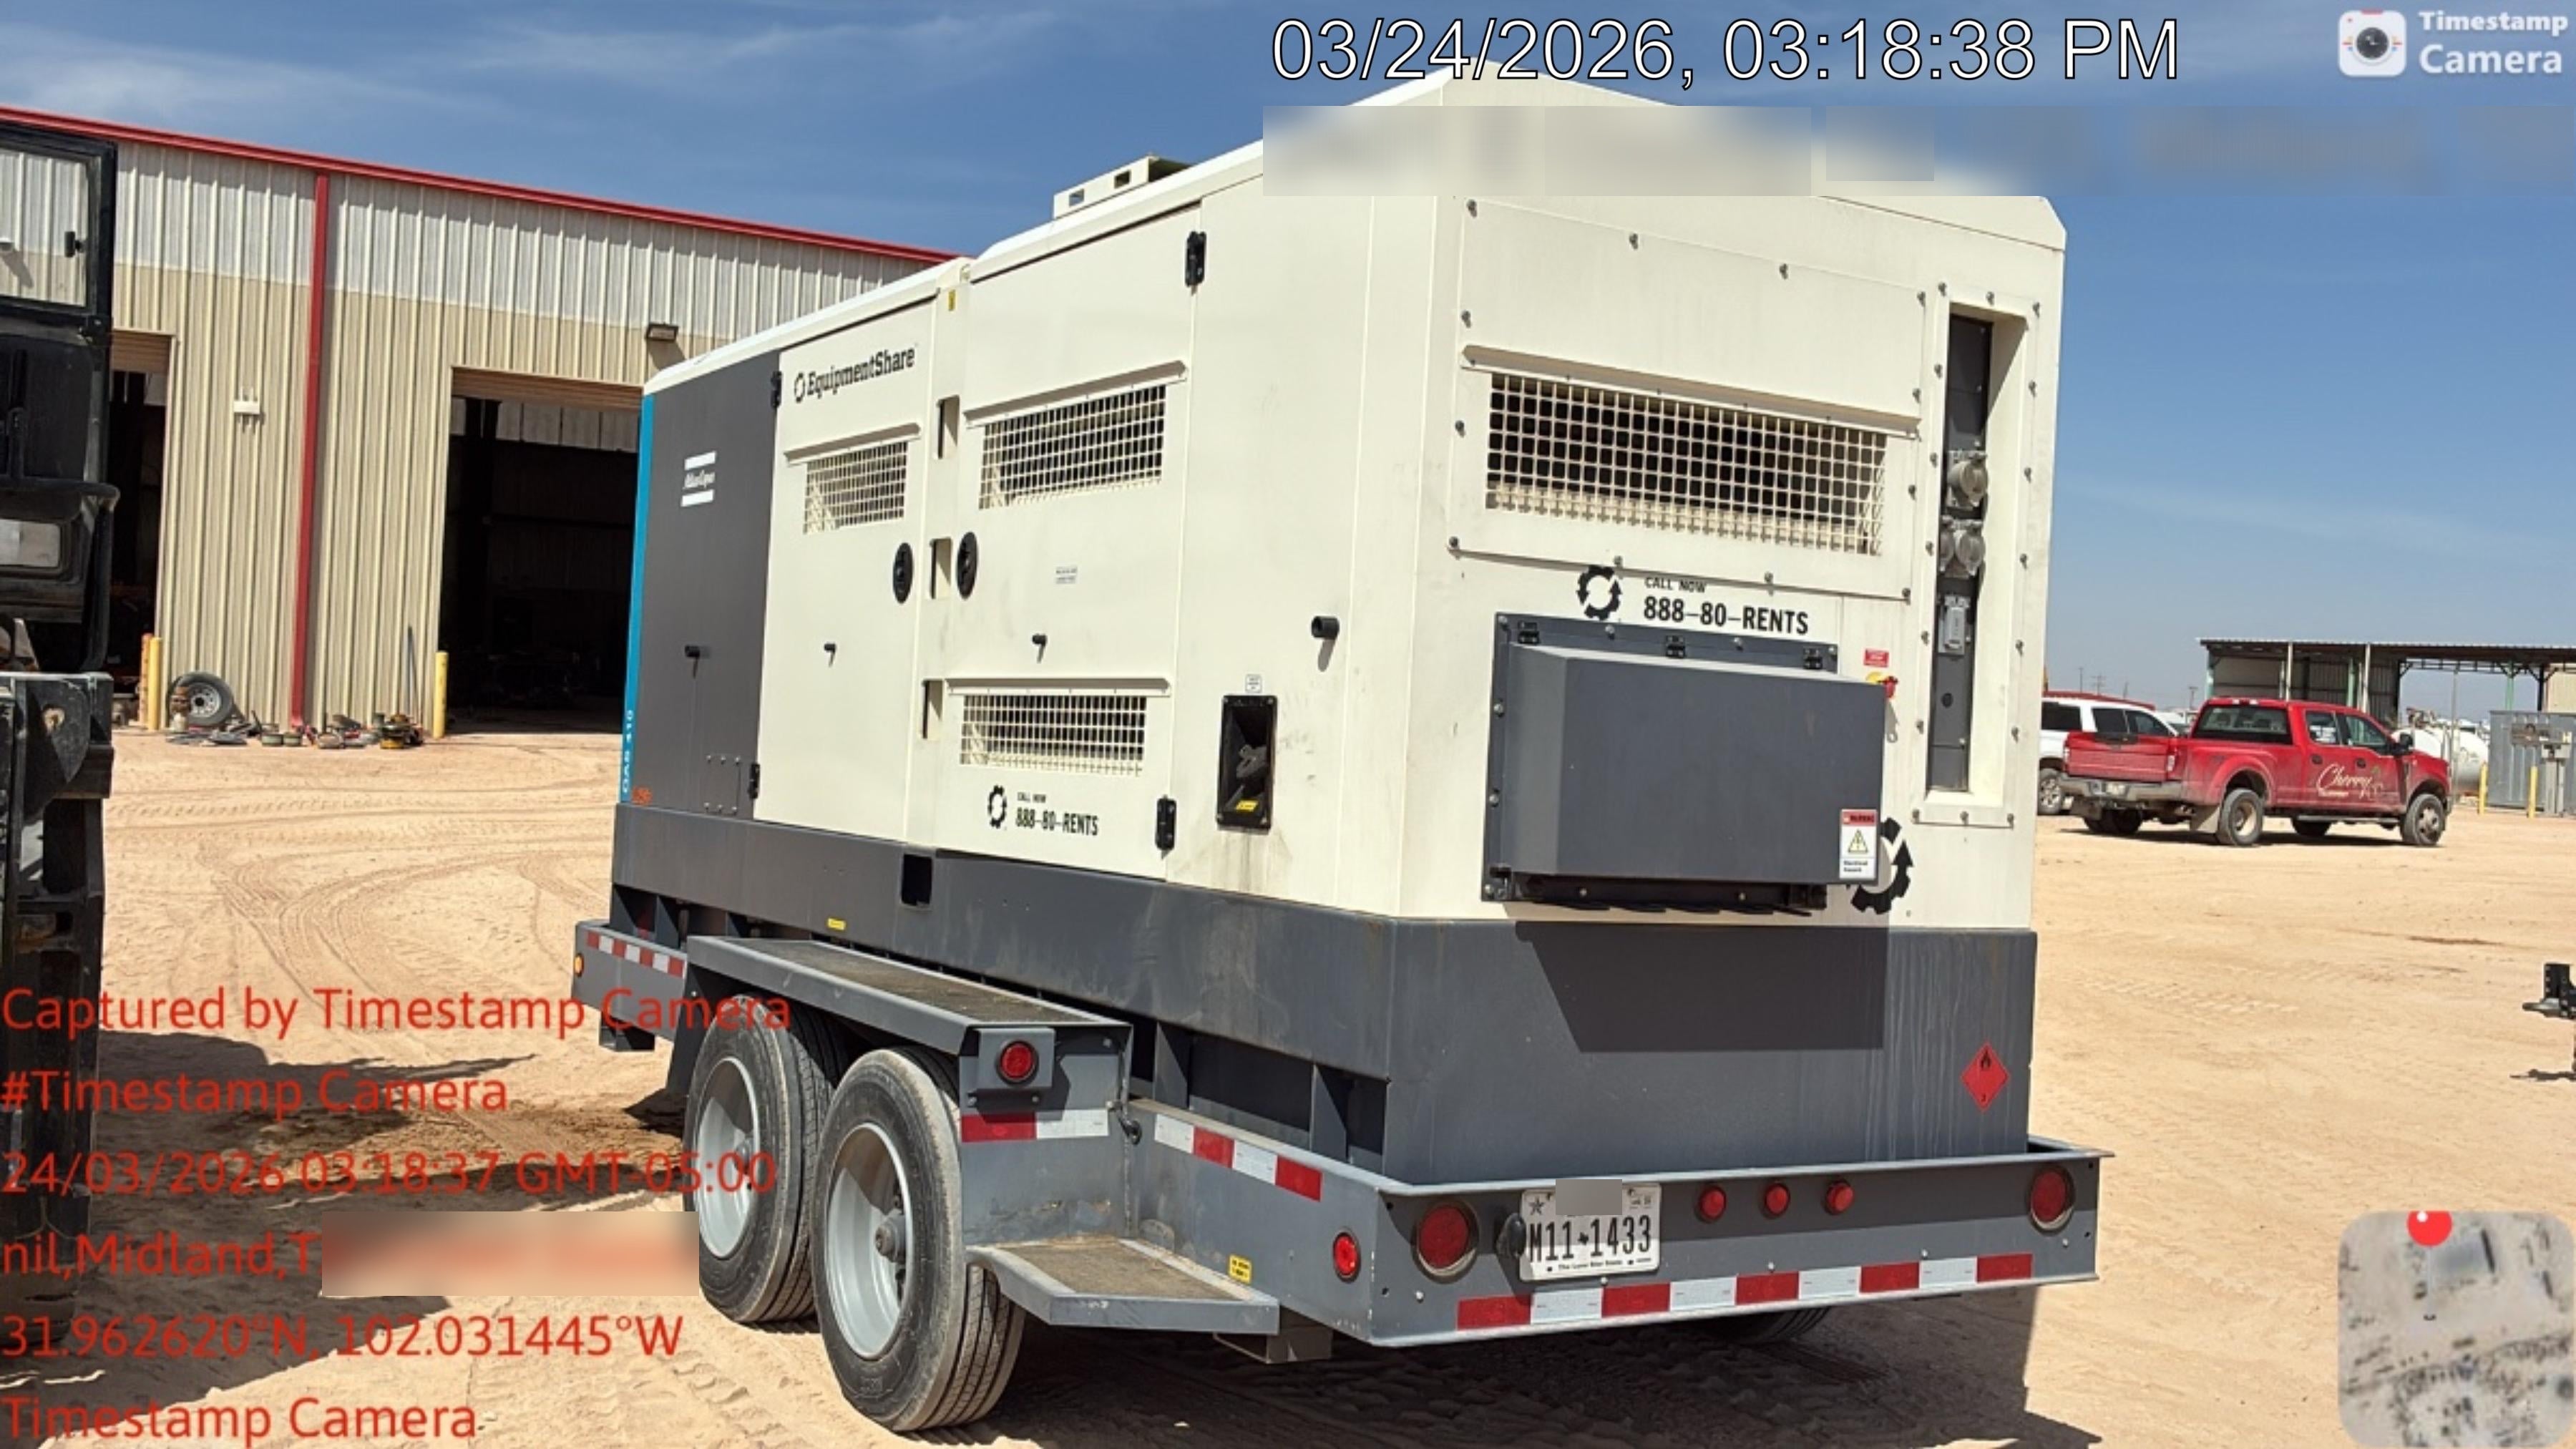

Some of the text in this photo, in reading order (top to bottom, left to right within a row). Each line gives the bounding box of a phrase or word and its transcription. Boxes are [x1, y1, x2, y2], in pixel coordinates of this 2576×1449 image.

[806, 347, 915, 399] EquipmentShare
[1644, 577, 1707, 593] CALL NOW
